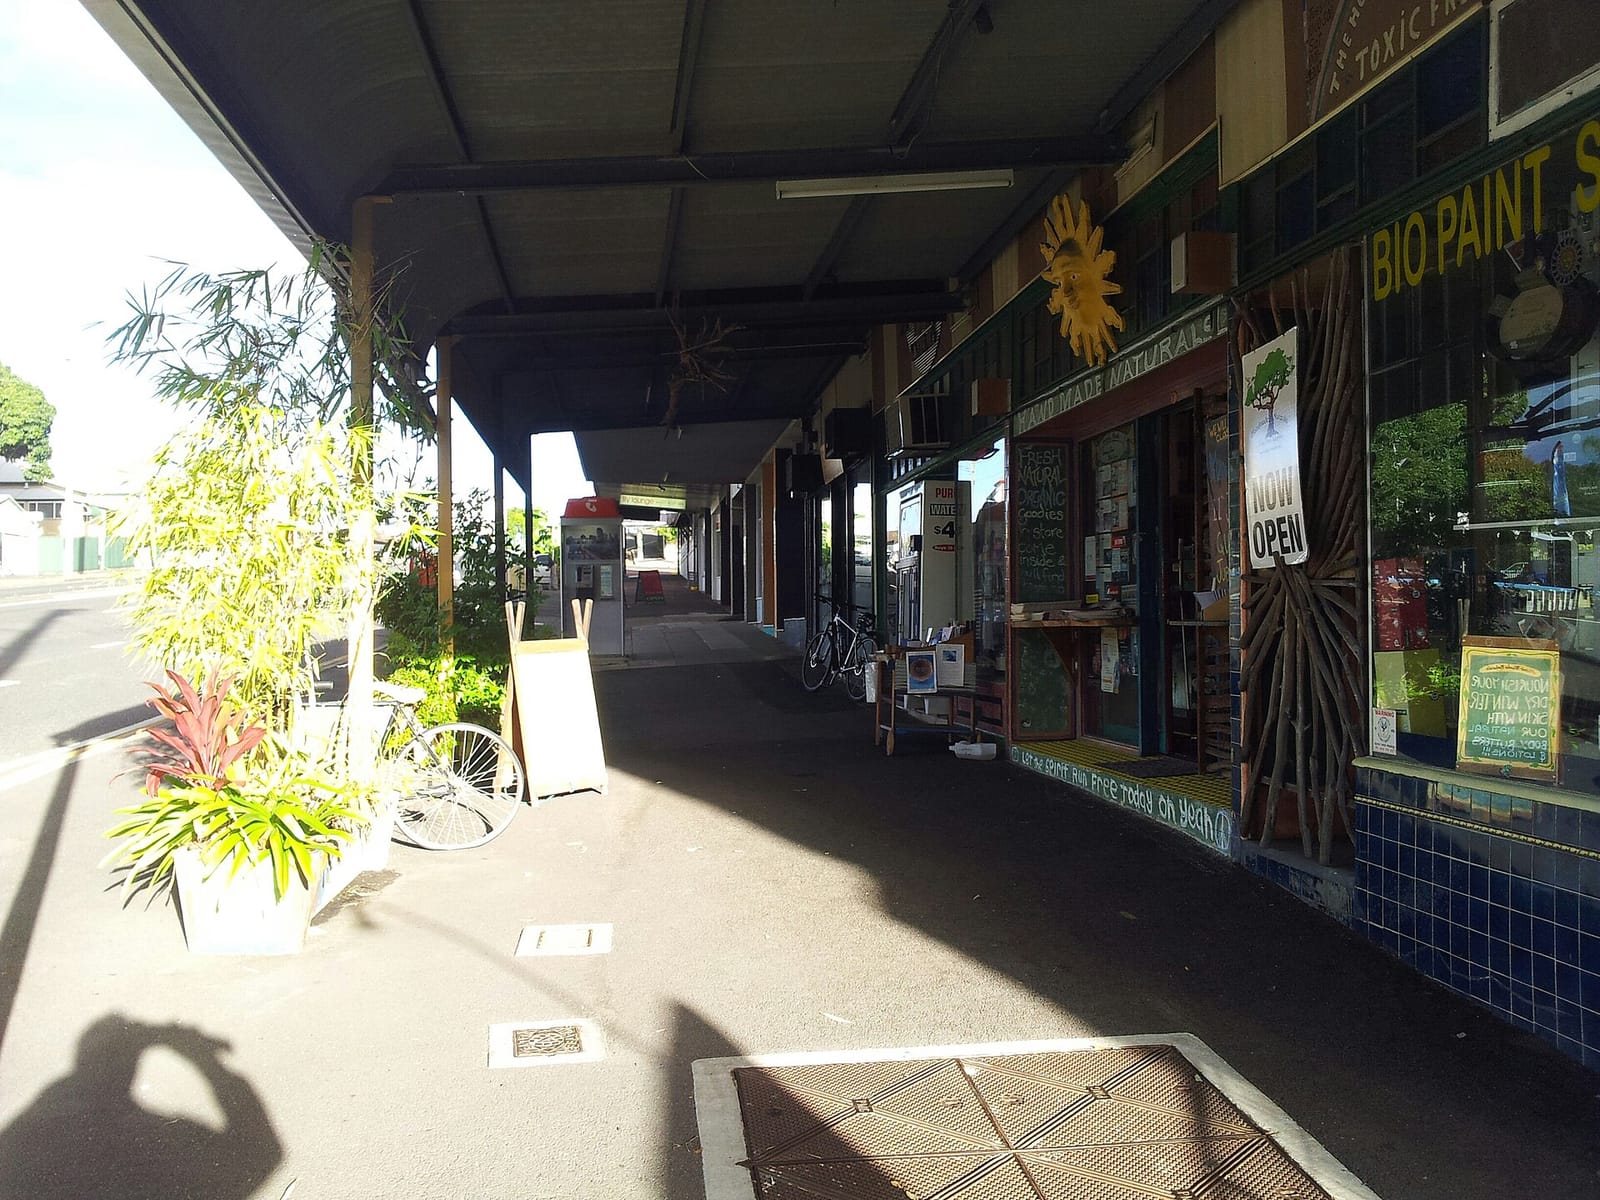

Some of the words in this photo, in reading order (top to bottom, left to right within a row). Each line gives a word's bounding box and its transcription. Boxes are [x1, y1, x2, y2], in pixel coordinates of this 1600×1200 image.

[1329, 32, 1352, 95] THE
[1372, 210, 1427, 302] BIO
[1436, 144, 1552, 275] PAINT
[1017, 396, 1055, 434] HAND
[1059, 374, 1103, 411] MADE
[1019, 446, 1062, 467] FRESH
[1019, 464, 1067, 487] NATURAL
[1253, 465, 1293, 513] NOW
[1252, 513, 1304, 559] OPEN
